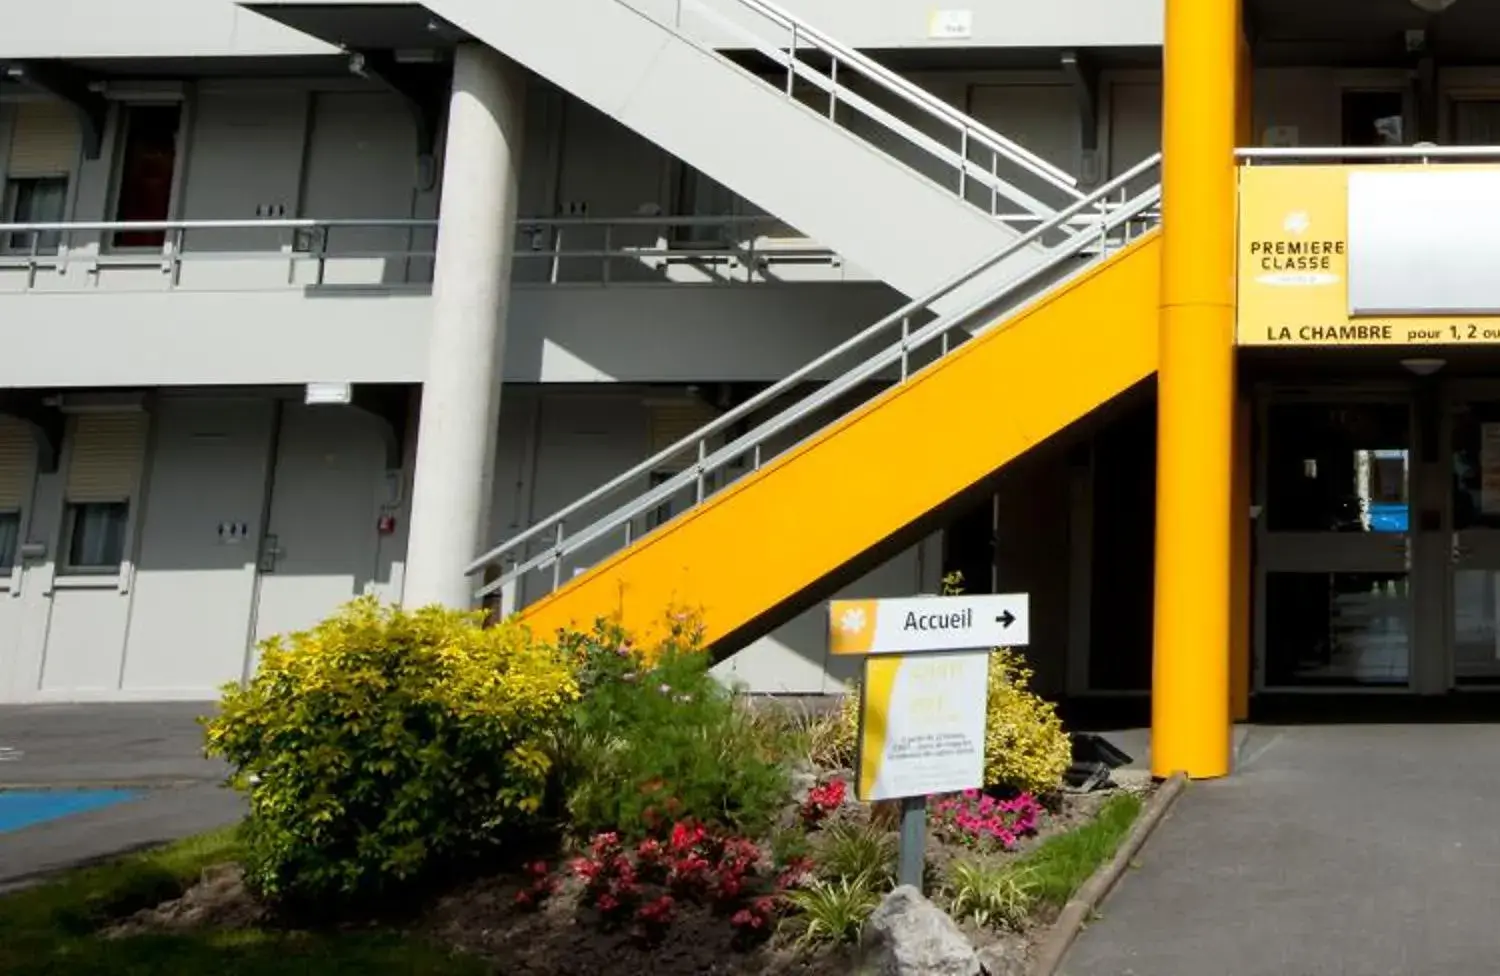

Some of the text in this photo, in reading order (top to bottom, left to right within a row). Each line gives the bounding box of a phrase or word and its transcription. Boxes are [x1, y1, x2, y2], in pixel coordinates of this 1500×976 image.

[1251, 241, 1345, 255] PREMIERE
[1261, 256, 1330, 270] CLASSE
[1267, 326, 1291, 341] LA
[1299, 325, 1393, 340] CHAMBRE
[1408, 328, 1441, 342] pour
[1450, 325, 1461, 340] 1,
[1467, 325, 1477, 339] 2
[1483, 328, 1500, 339] ou
[904, 607, 973, 631] Accueil
